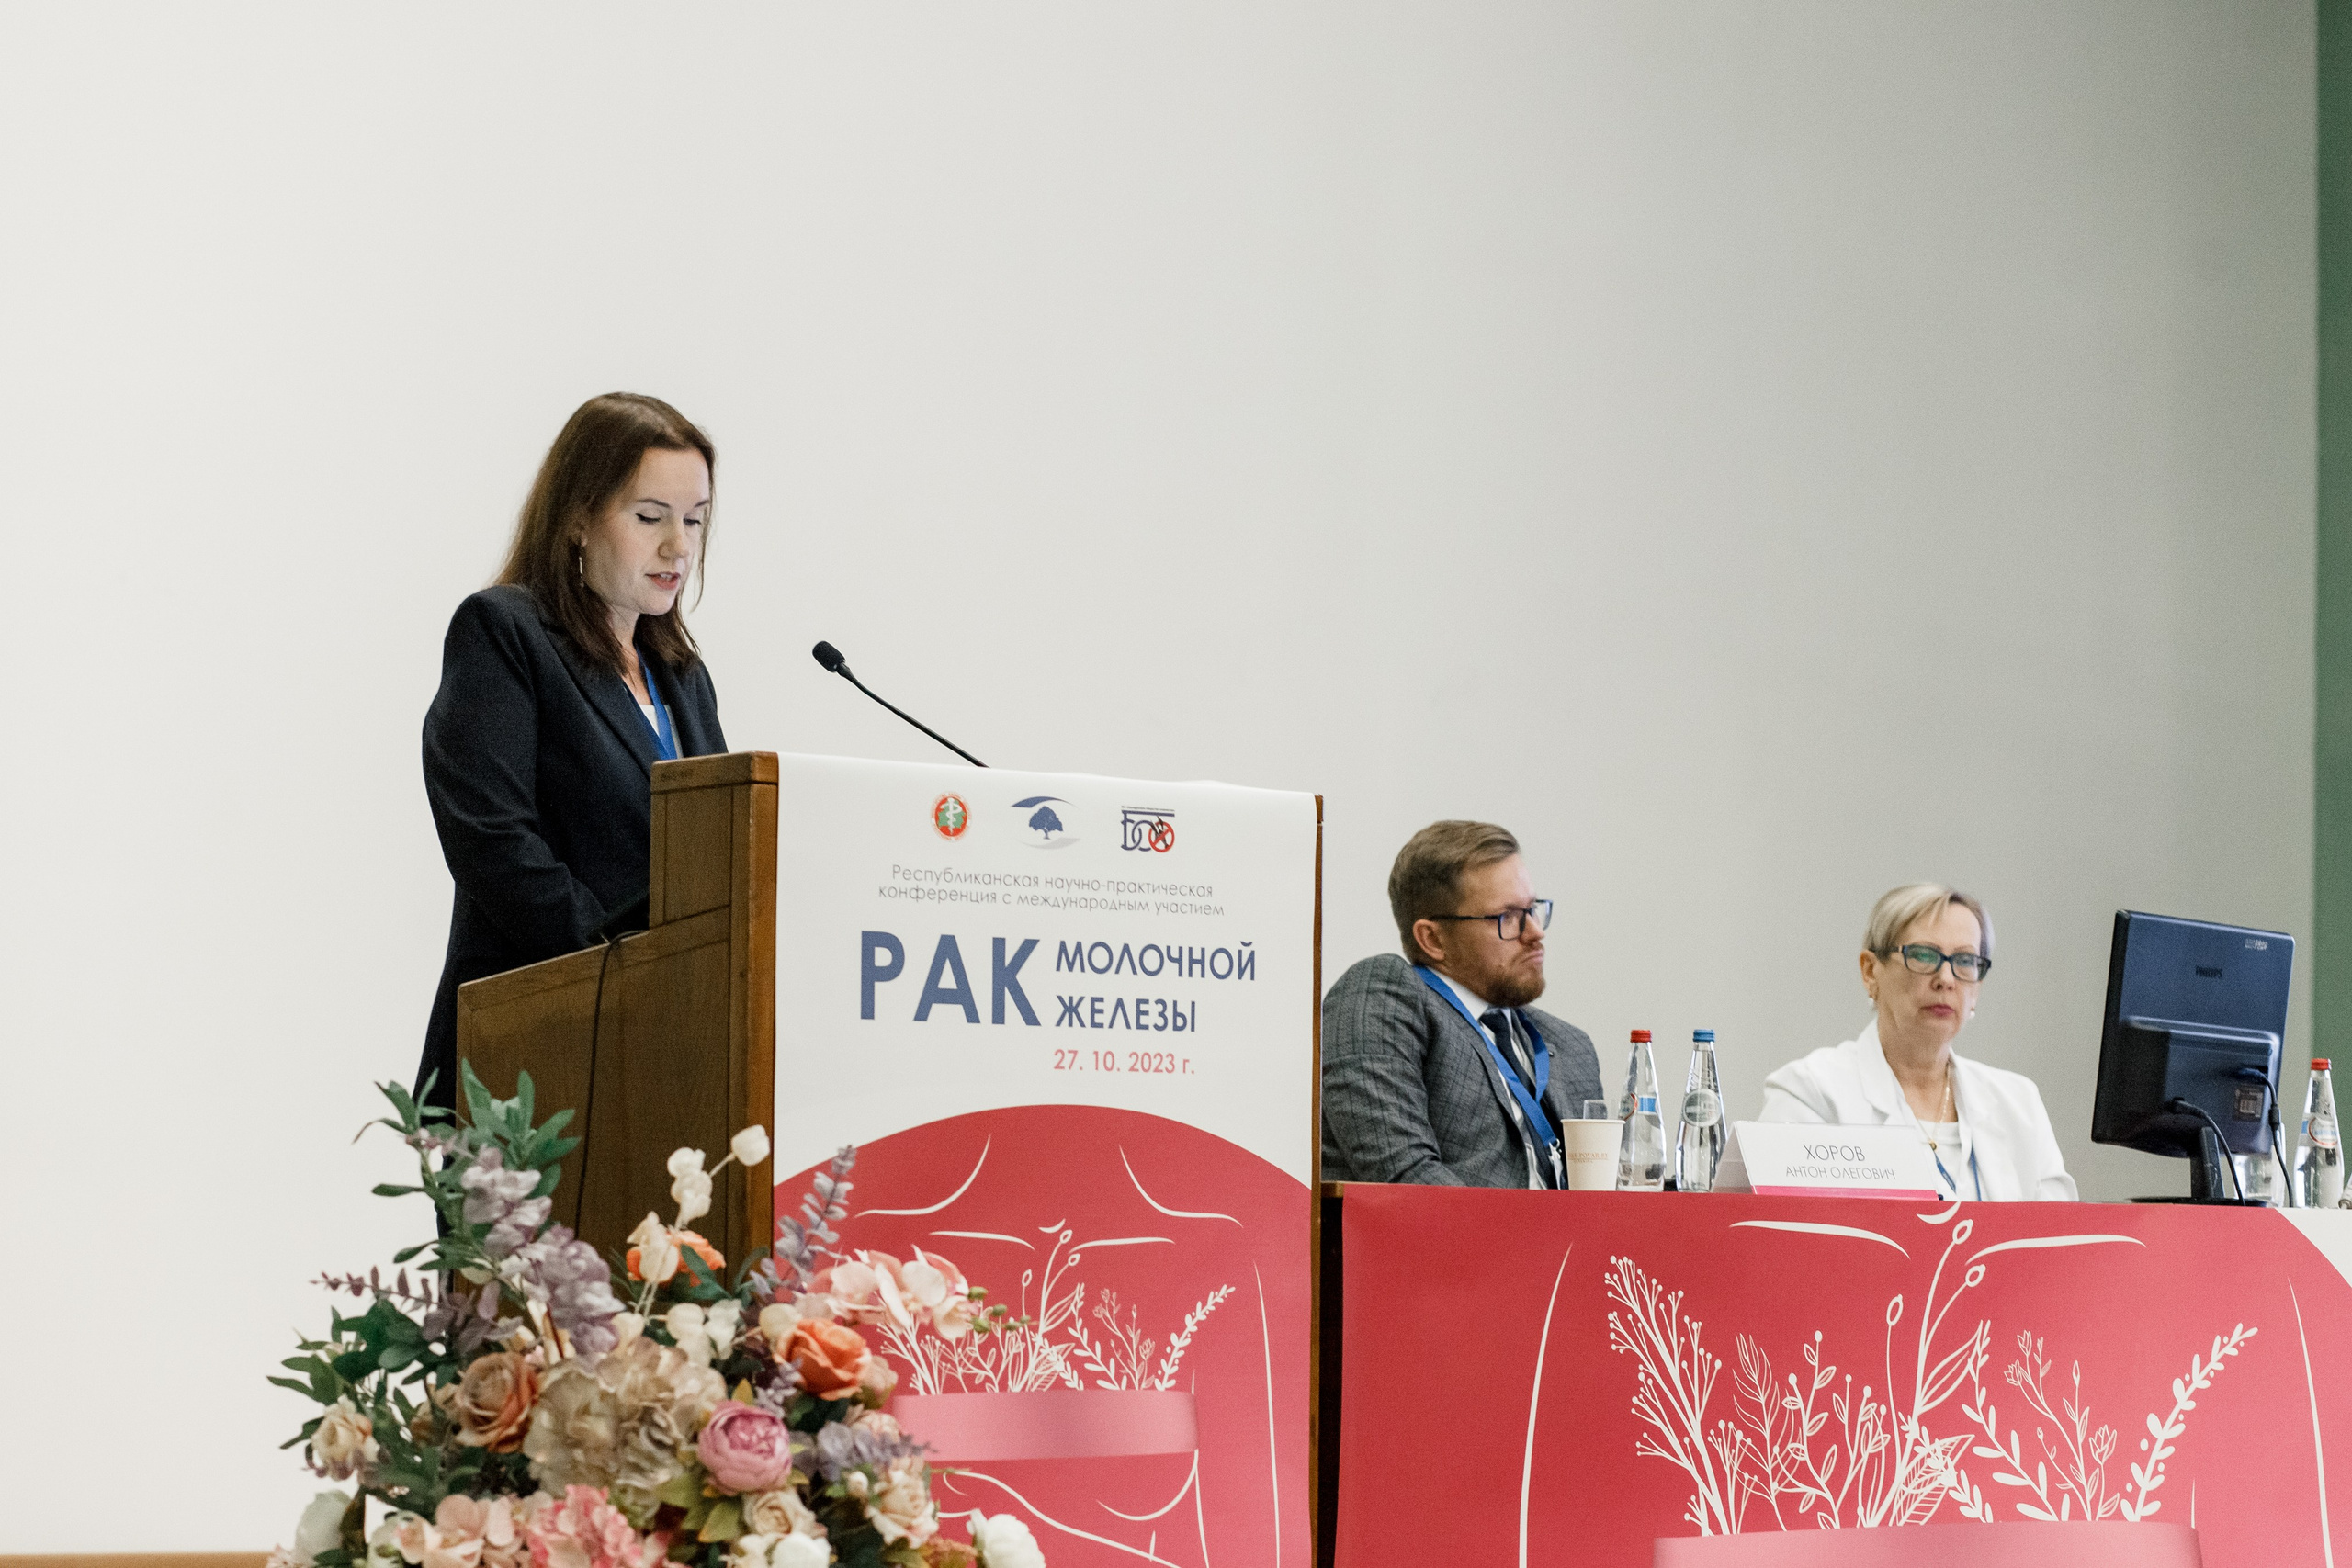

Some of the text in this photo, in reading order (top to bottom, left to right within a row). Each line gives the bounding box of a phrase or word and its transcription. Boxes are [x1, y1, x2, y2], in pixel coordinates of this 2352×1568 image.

[892, 864, 1213, 897] Республиканская научно-практическая
[878, 885, 1225, 916] конференция с международным участием
[1056, 940, 1255, 981] МОЛОЧНОЙ
[860, 931, 1042, 1027] РАК
[1055, 995, 1195, 1032] ЖЕЛЕЗЫ
[1054, 1048, 1194, 1074] 27. 10. 2023 г.
[1803, 1145, 1866, 1161] ХОРОВ
[1785, 1166, 1895, 1179] АНТОН ОЛЕГОВИЧ
